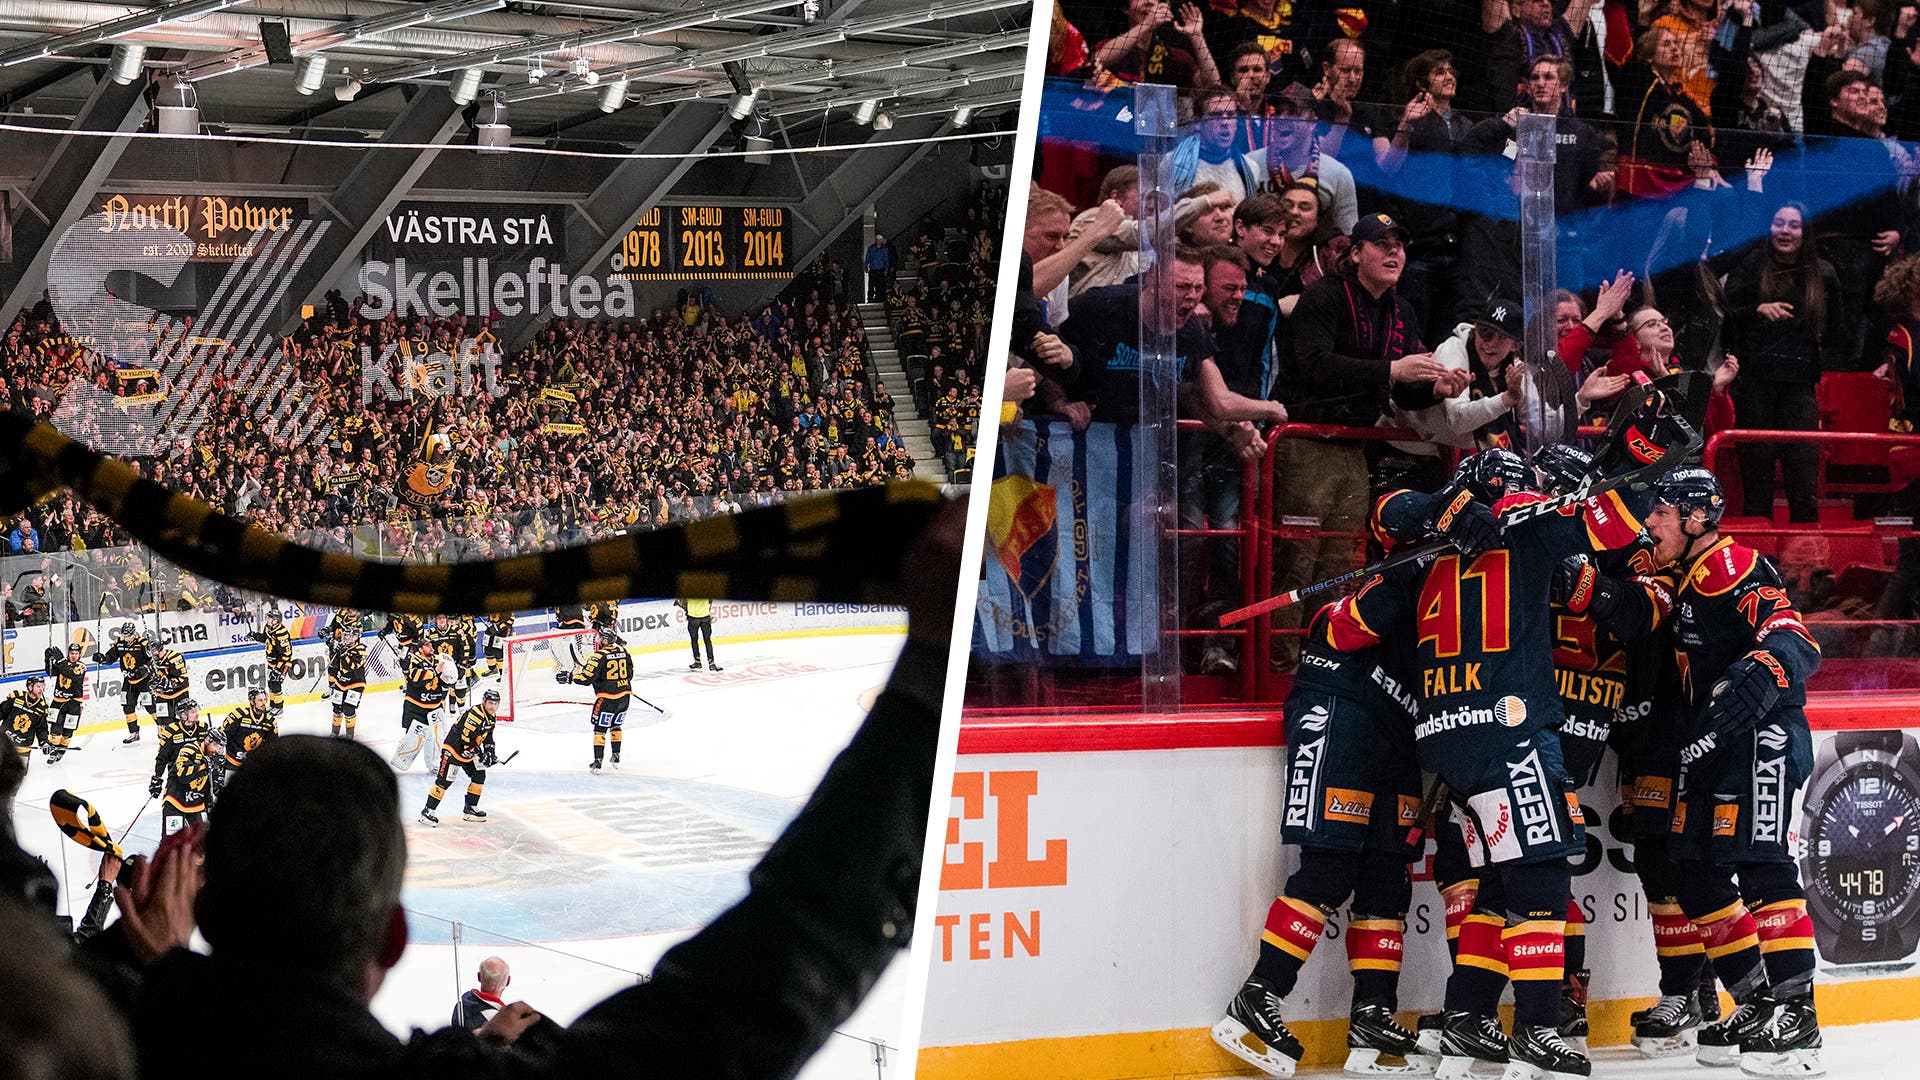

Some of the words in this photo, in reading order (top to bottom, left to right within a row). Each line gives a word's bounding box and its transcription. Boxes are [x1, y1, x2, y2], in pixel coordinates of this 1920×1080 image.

[97, 194, 190, 236] North
[200, 196, 294, 238] Power
[386, 210, 498, 244] VÄSTRA
[502, 214, 554, 245] STÅ
[165, 243, 193, 257] 2001
[622, 230, 661, 267] 1978
[682, 230, 725, 267] 2013
[743, 231, 784, 267] 2014
[357, 252, 635, 320] Skellefteå
[360, 337, 505, 404] Kraft
[1507, 473, 1593, 526] CCM
[1417, 549, 1511, 658] 41
[1737, 585, 1792, 628] 79
[205, 655, 327, 692] engon
[606, 658, 629, 680] 28
[1424, 662, 1483, 699] FALK
[1285, 737, 1323, 828] REFIX
[1506, 751, 1554, 847] REFIX
[1755, 756, 1781, 843] REFIX
[1858, 777, 1880, 795] 12
[1855, 800, 1884, 809] TISSOT
[1818, 839, 1832, 857] 9
[1906, 834, 1920, 852] 3
[1839, 869, 1884, 896] 4478
[1862, 900, 1876, 915] 6
[935, 910, 1041, 962] TEN
[1513, 943, 1564, 957] Stavdal
[1861, 928, 1877, 942] S
[1382, 1029, 1406, 1041] CCM
[1479, 1038, 1504, 1051] CCM
[1527, 1042, 1548, 1056] CCM
